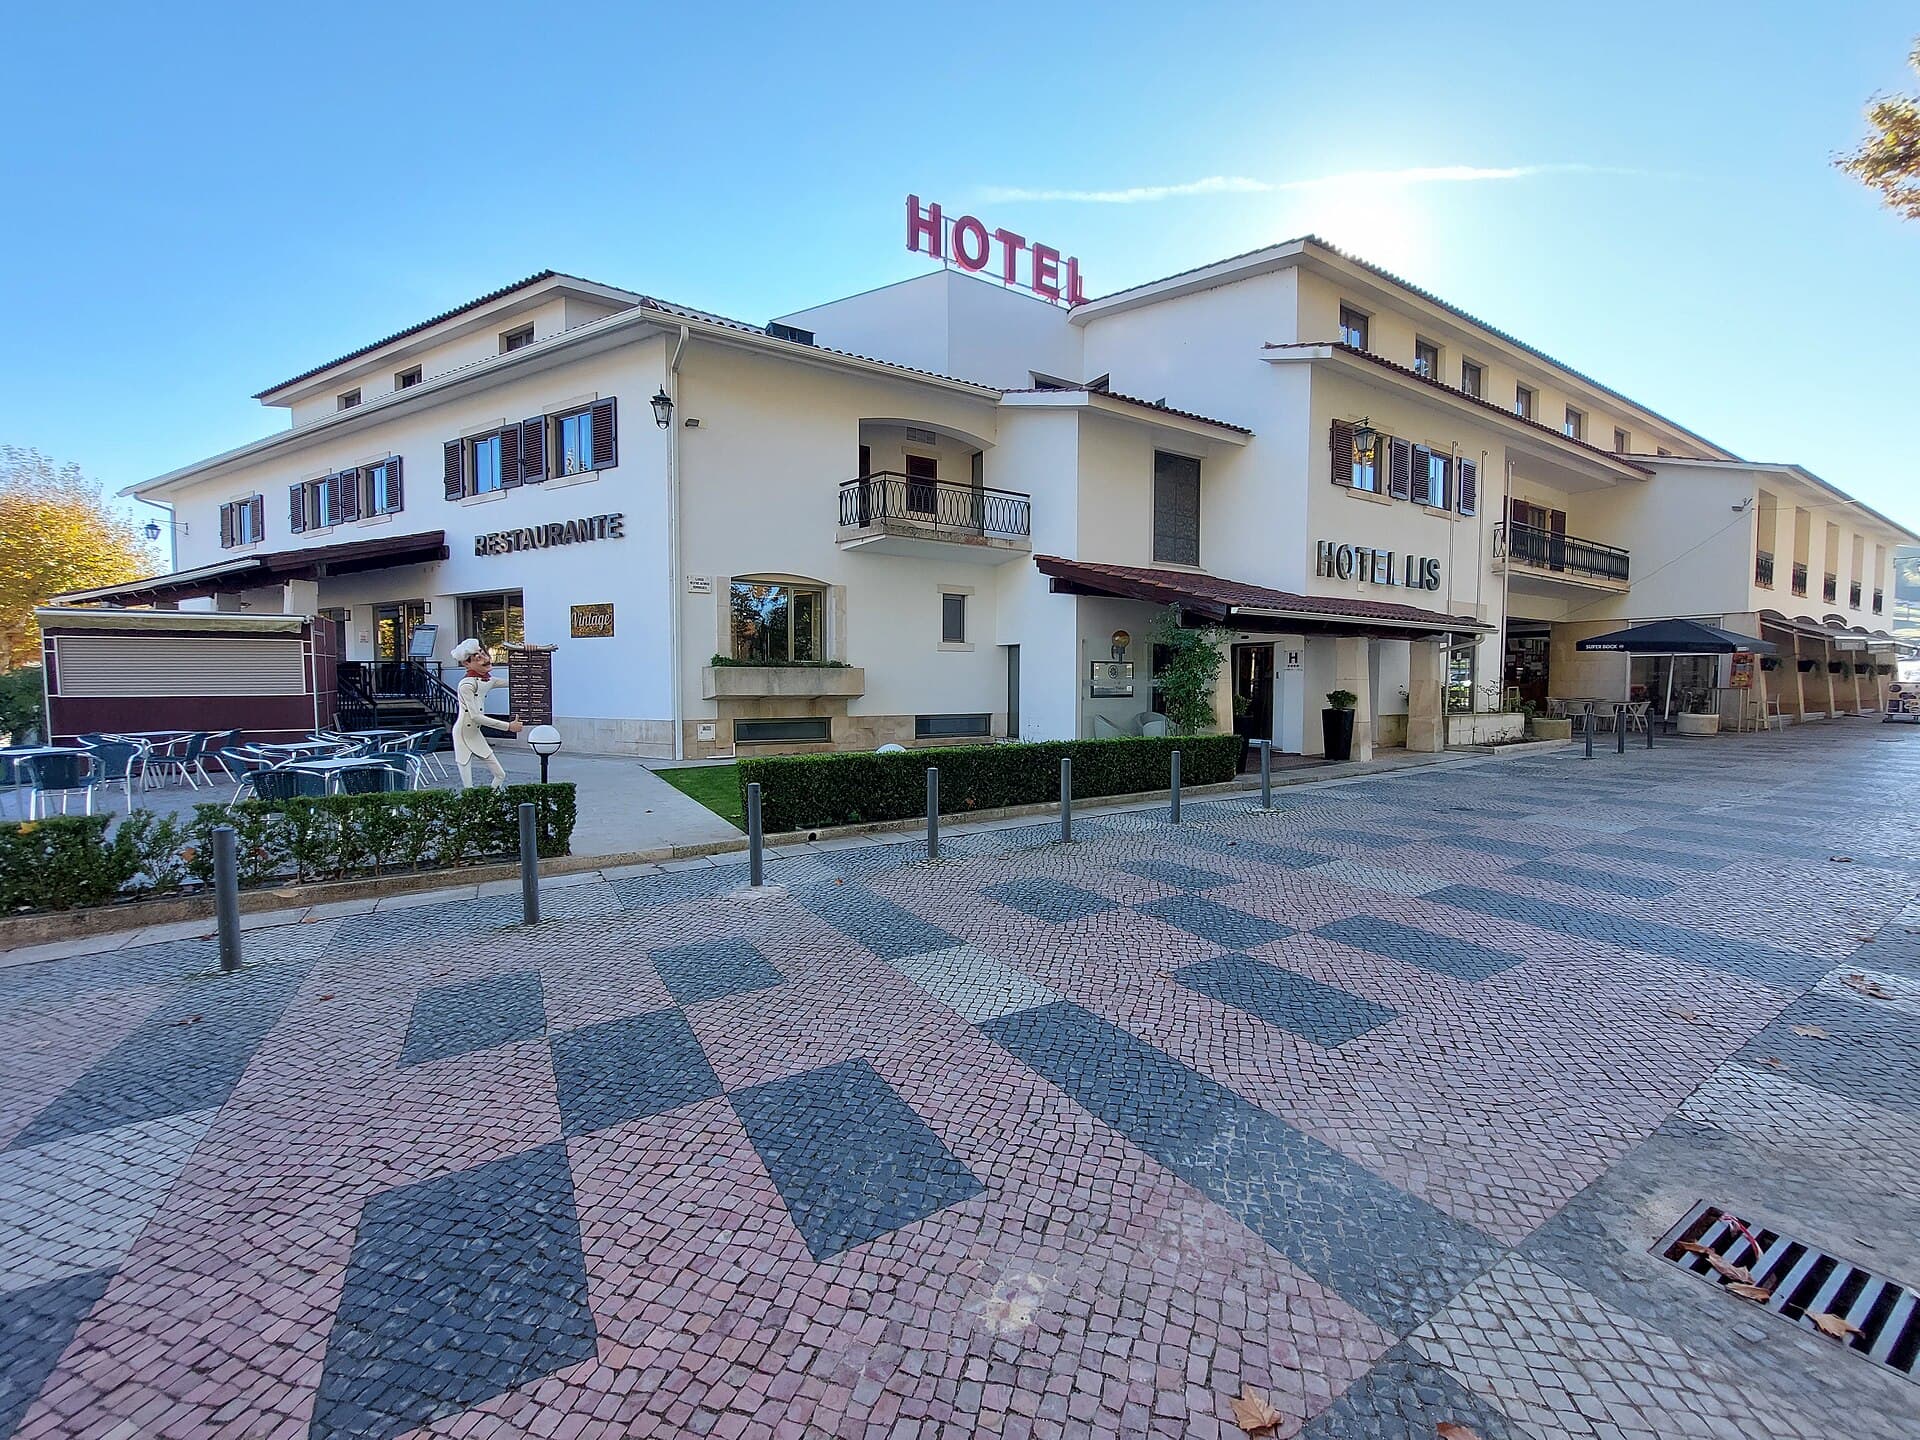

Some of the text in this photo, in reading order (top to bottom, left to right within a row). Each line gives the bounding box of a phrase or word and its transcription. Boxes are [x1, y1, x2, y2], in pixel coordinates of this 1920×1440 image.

[906, 193, 1089, 306] HOTEL
[474, 512, 625, 557] RESTAURANTE
[1316, 540, 1441, 591] HOTEL LIS
[572, 611, 612, 630] Vintage
[1288, 652, 1298, 664] H
